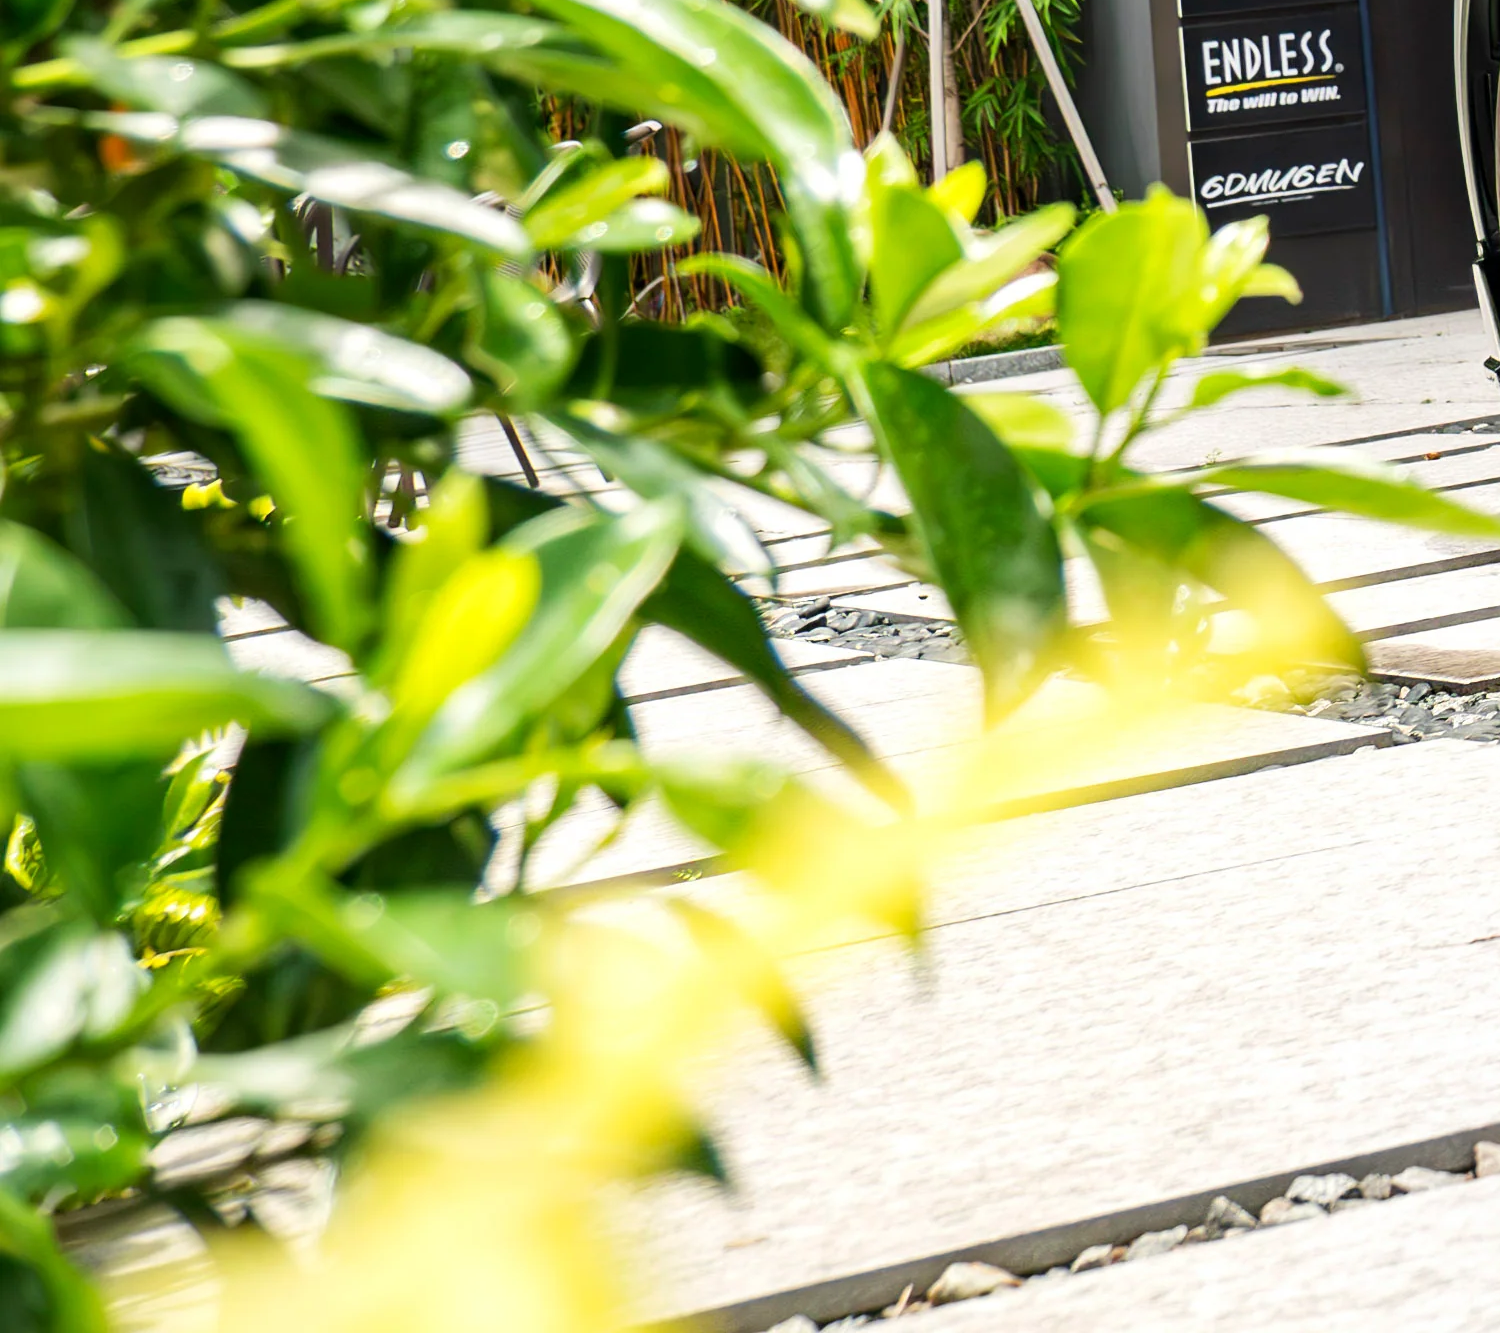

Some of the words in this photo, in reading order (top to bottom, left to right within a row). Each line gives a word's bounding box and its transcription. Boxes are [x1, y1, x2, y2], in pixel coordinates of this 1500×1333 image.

[1202, 29, 1334, 85] ENDLESS
[1207, 98, 1241, 113] The
[1243, 92, 1277, 110] will
[1279, 91, 1298, 106] to
[1301, 85, 1341, 103] WIN.
